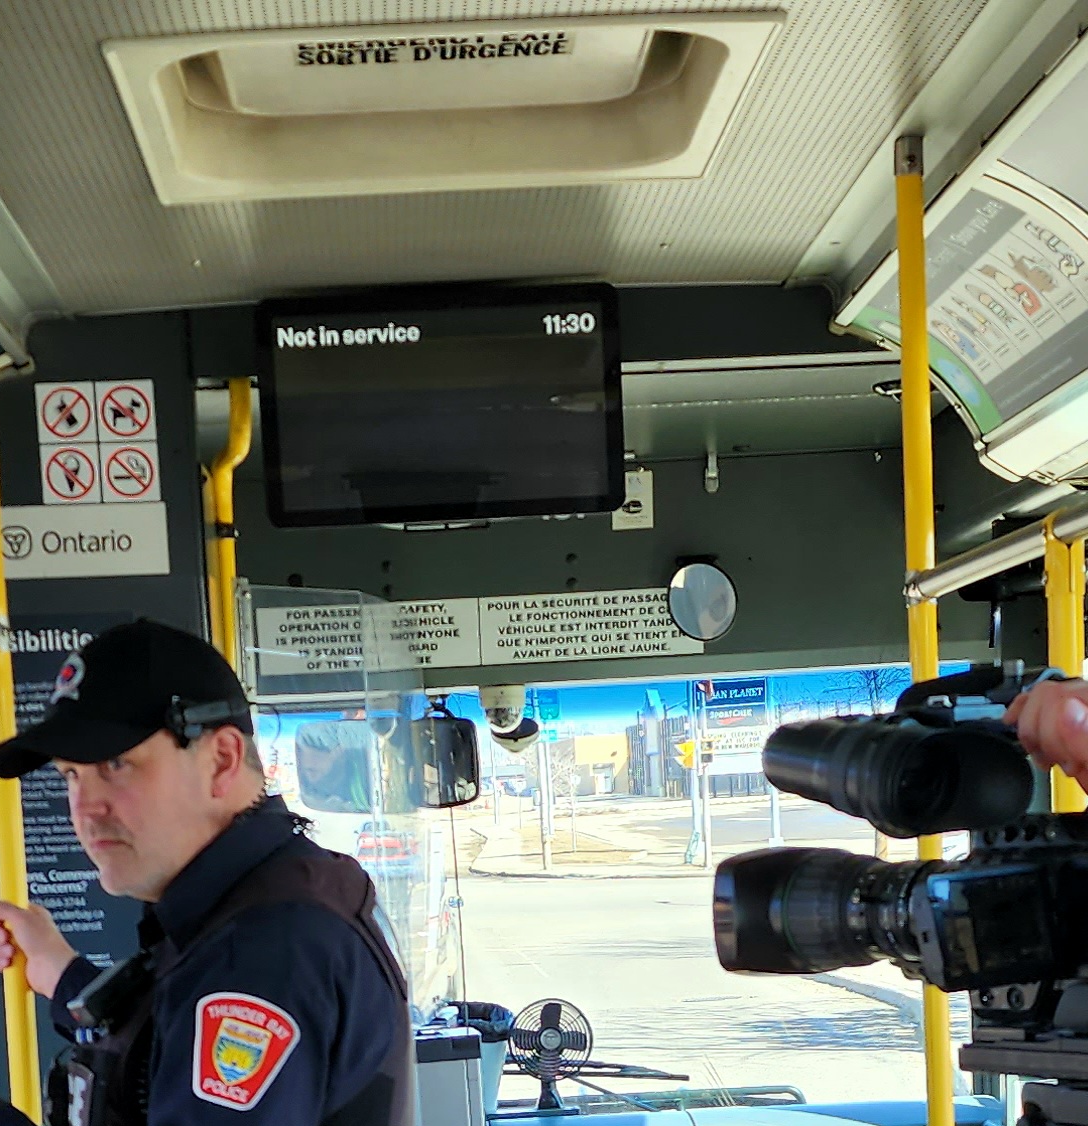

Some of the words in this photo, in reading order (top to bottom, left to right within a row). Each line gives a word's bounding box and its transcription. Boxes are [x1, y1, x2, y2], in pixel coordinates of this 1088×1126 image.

[297, 47, 398, 66] SORTIE
[413, 40, 569, 62] D'URGENCE
[542, 312, 595, 336] 11:30
[276, 324, 316, 349] Not
[318, 324, 340, 347] in
[342, 323, 421, 347] service
[42, 530, 132, 554] Ontario
[487, 601, 520, 612] POUR
[524, 599, 538, 609] LA
[541, 595, 599, 608] SÉCURITÉ
[603, 595, 619, 605] DE
[622, 593, 669, 604] PASSAG
[286, 610, 310, 620] FOR
[509, 613, 522, 623] LE
[527, 607, 635, 621] FONCTIONNEMENT
[639, 605, 654, 616] DE
[658, 604, 669, 615] C
[279, 622, 349, 633] OPERATION
[560, 621, 581, 632] EST
[585, 619, 639, 631] INTERDIT
[643, 617, 674, 628] TAND
[275, 637, 287, 646] IS
[497, 637, 521, 648] QUE
[525, 634, 588, 646] N'IMPORTE
[591, 632, 612, 643] QUI
[616, 632, 630, 641] SE
[634, 630, 667, 641] TIENT
[513, 648, 551, 660] AVANT
[555, 647, 570, 658] DE
[573, 646, 588, 656] LA
[591, 645, 626, 656] LIGNE
[307, 660, 321, 670] OF
[327, 659, 351, 670] THE
[729, 687, 763, 698] PLANET
[203, 1077, 250, 1103] POLICE
